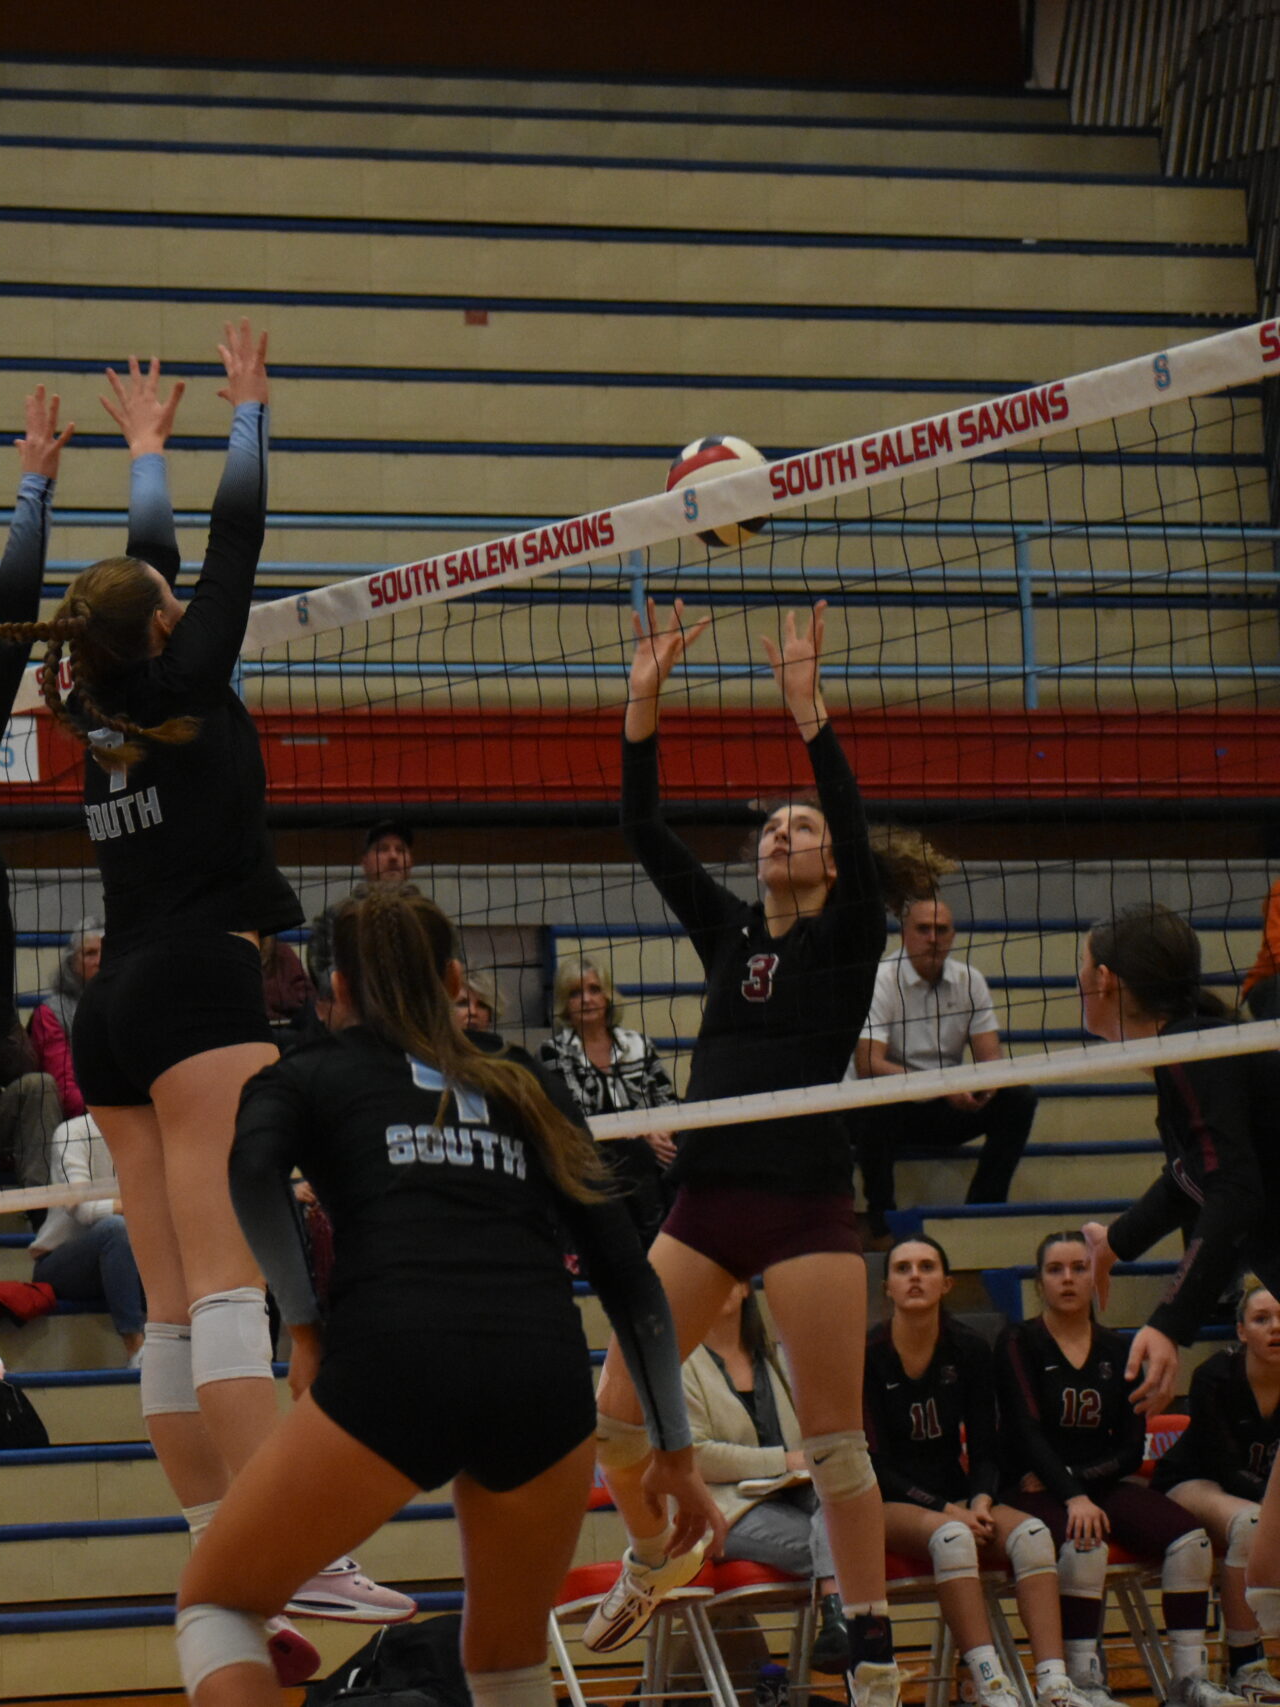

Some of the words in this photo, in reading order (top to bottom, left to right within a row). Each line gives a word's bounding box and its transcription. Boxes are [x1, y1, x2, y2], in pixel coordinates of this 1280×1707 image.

[769, 450, 857, 500] SOUTH
[860, 416, 953, 474] SALEM
[958, 383, 1069, 449] SAXONS
[368, 560, 441, 609] SOUTH
[444, 537, 519, 588] SALEM
[521, 512, 615, 567] SAXONS
[741, 952, 780, 1004] 3
[385, 1123, 528, 1182] SOUTH
[909, 1396, 943, 1441] 11
[1059, 1386, 1103, 1428] 12
